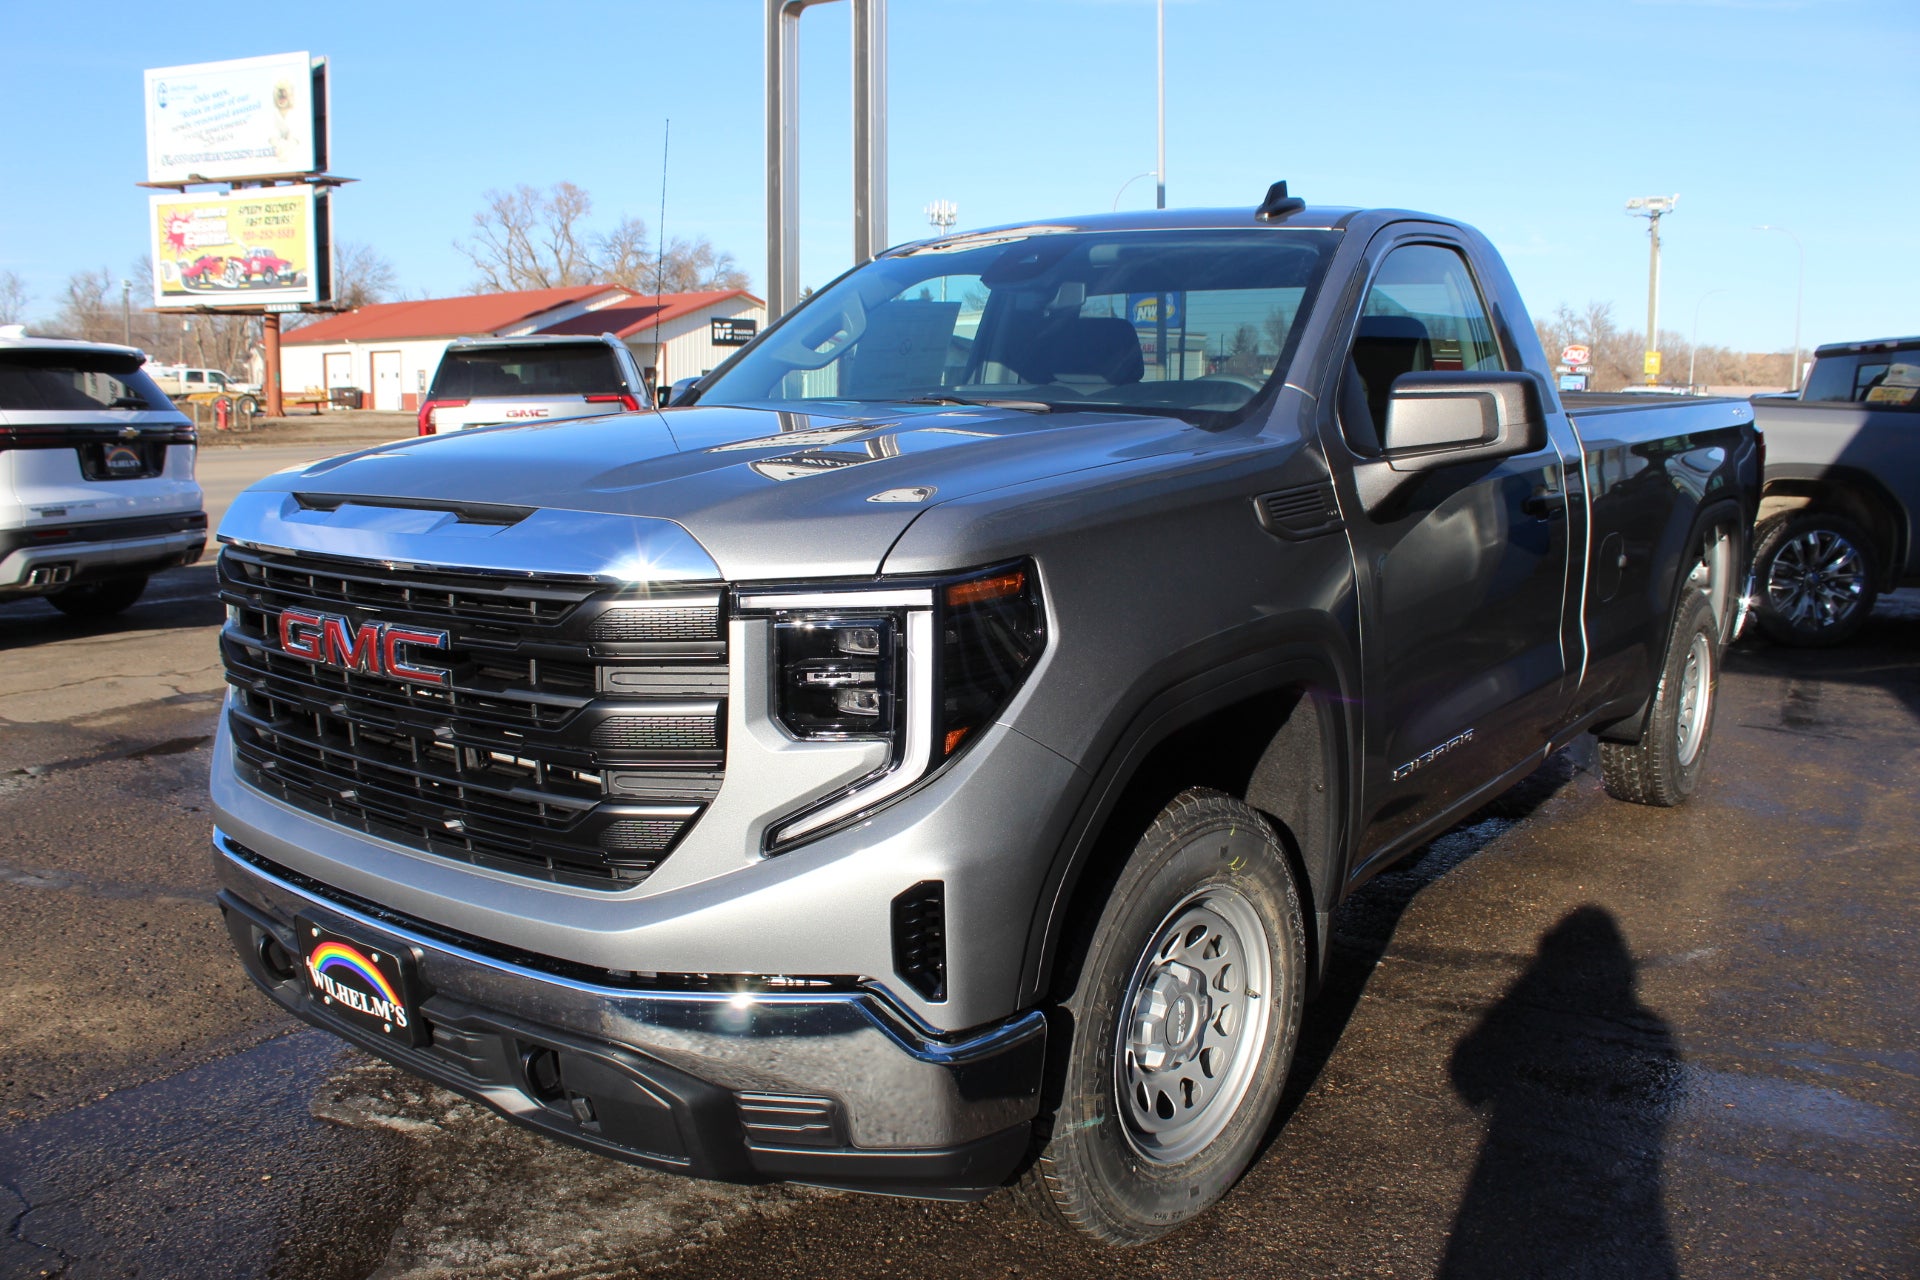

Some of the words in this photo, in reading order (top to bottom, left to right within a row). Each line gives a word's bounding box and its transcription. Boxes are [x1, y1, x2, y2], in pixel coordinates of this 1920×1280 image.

[506, 409, 549, 418] GMC
[279, 605, 453, 689] GMC
[1393, 728, 1475, 781] SIERRA
[306, 956, 408, 1028] WILHELM'S
